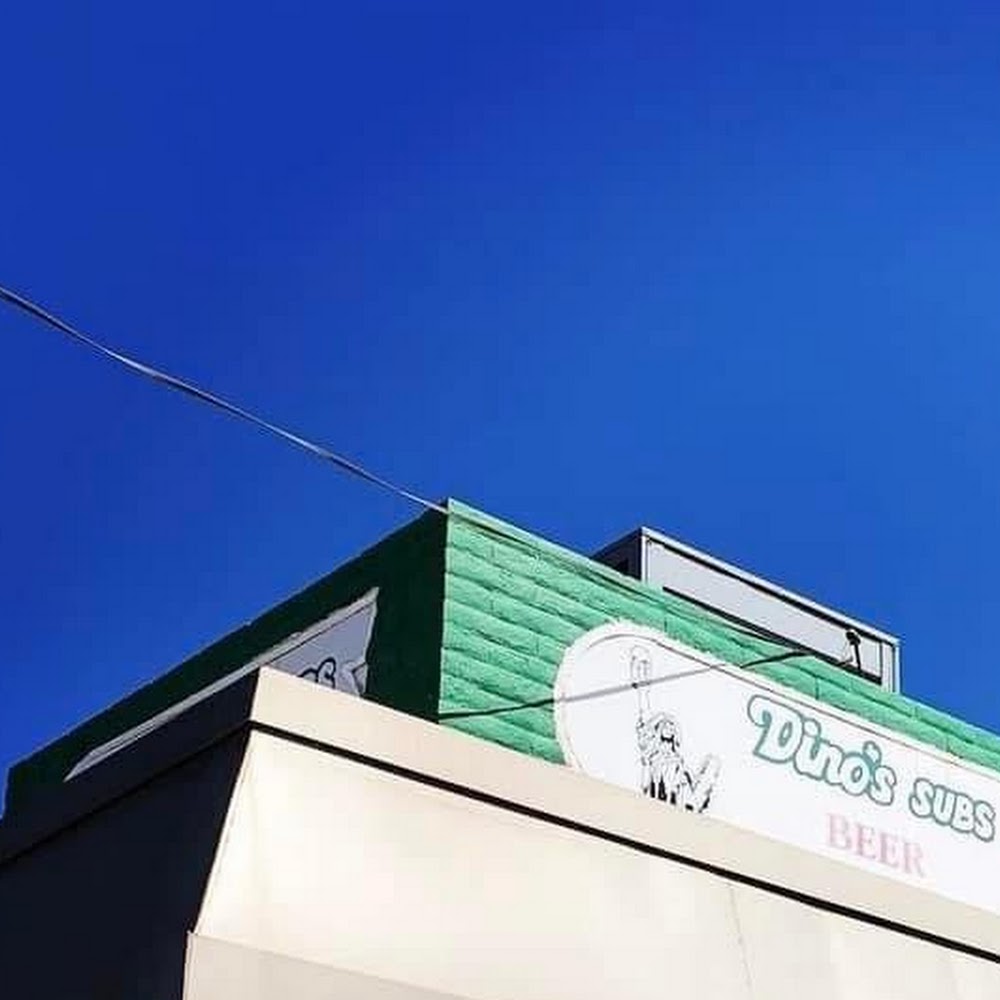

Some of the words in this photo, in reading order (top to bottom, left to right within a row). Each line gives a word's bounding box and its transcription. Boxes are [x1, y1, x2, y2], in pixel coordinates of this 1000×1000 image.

[747, 694, 896, 805] Dino's
[908, 777, 996, 843] SUBS
[826, 813, 925, 877] BEER
